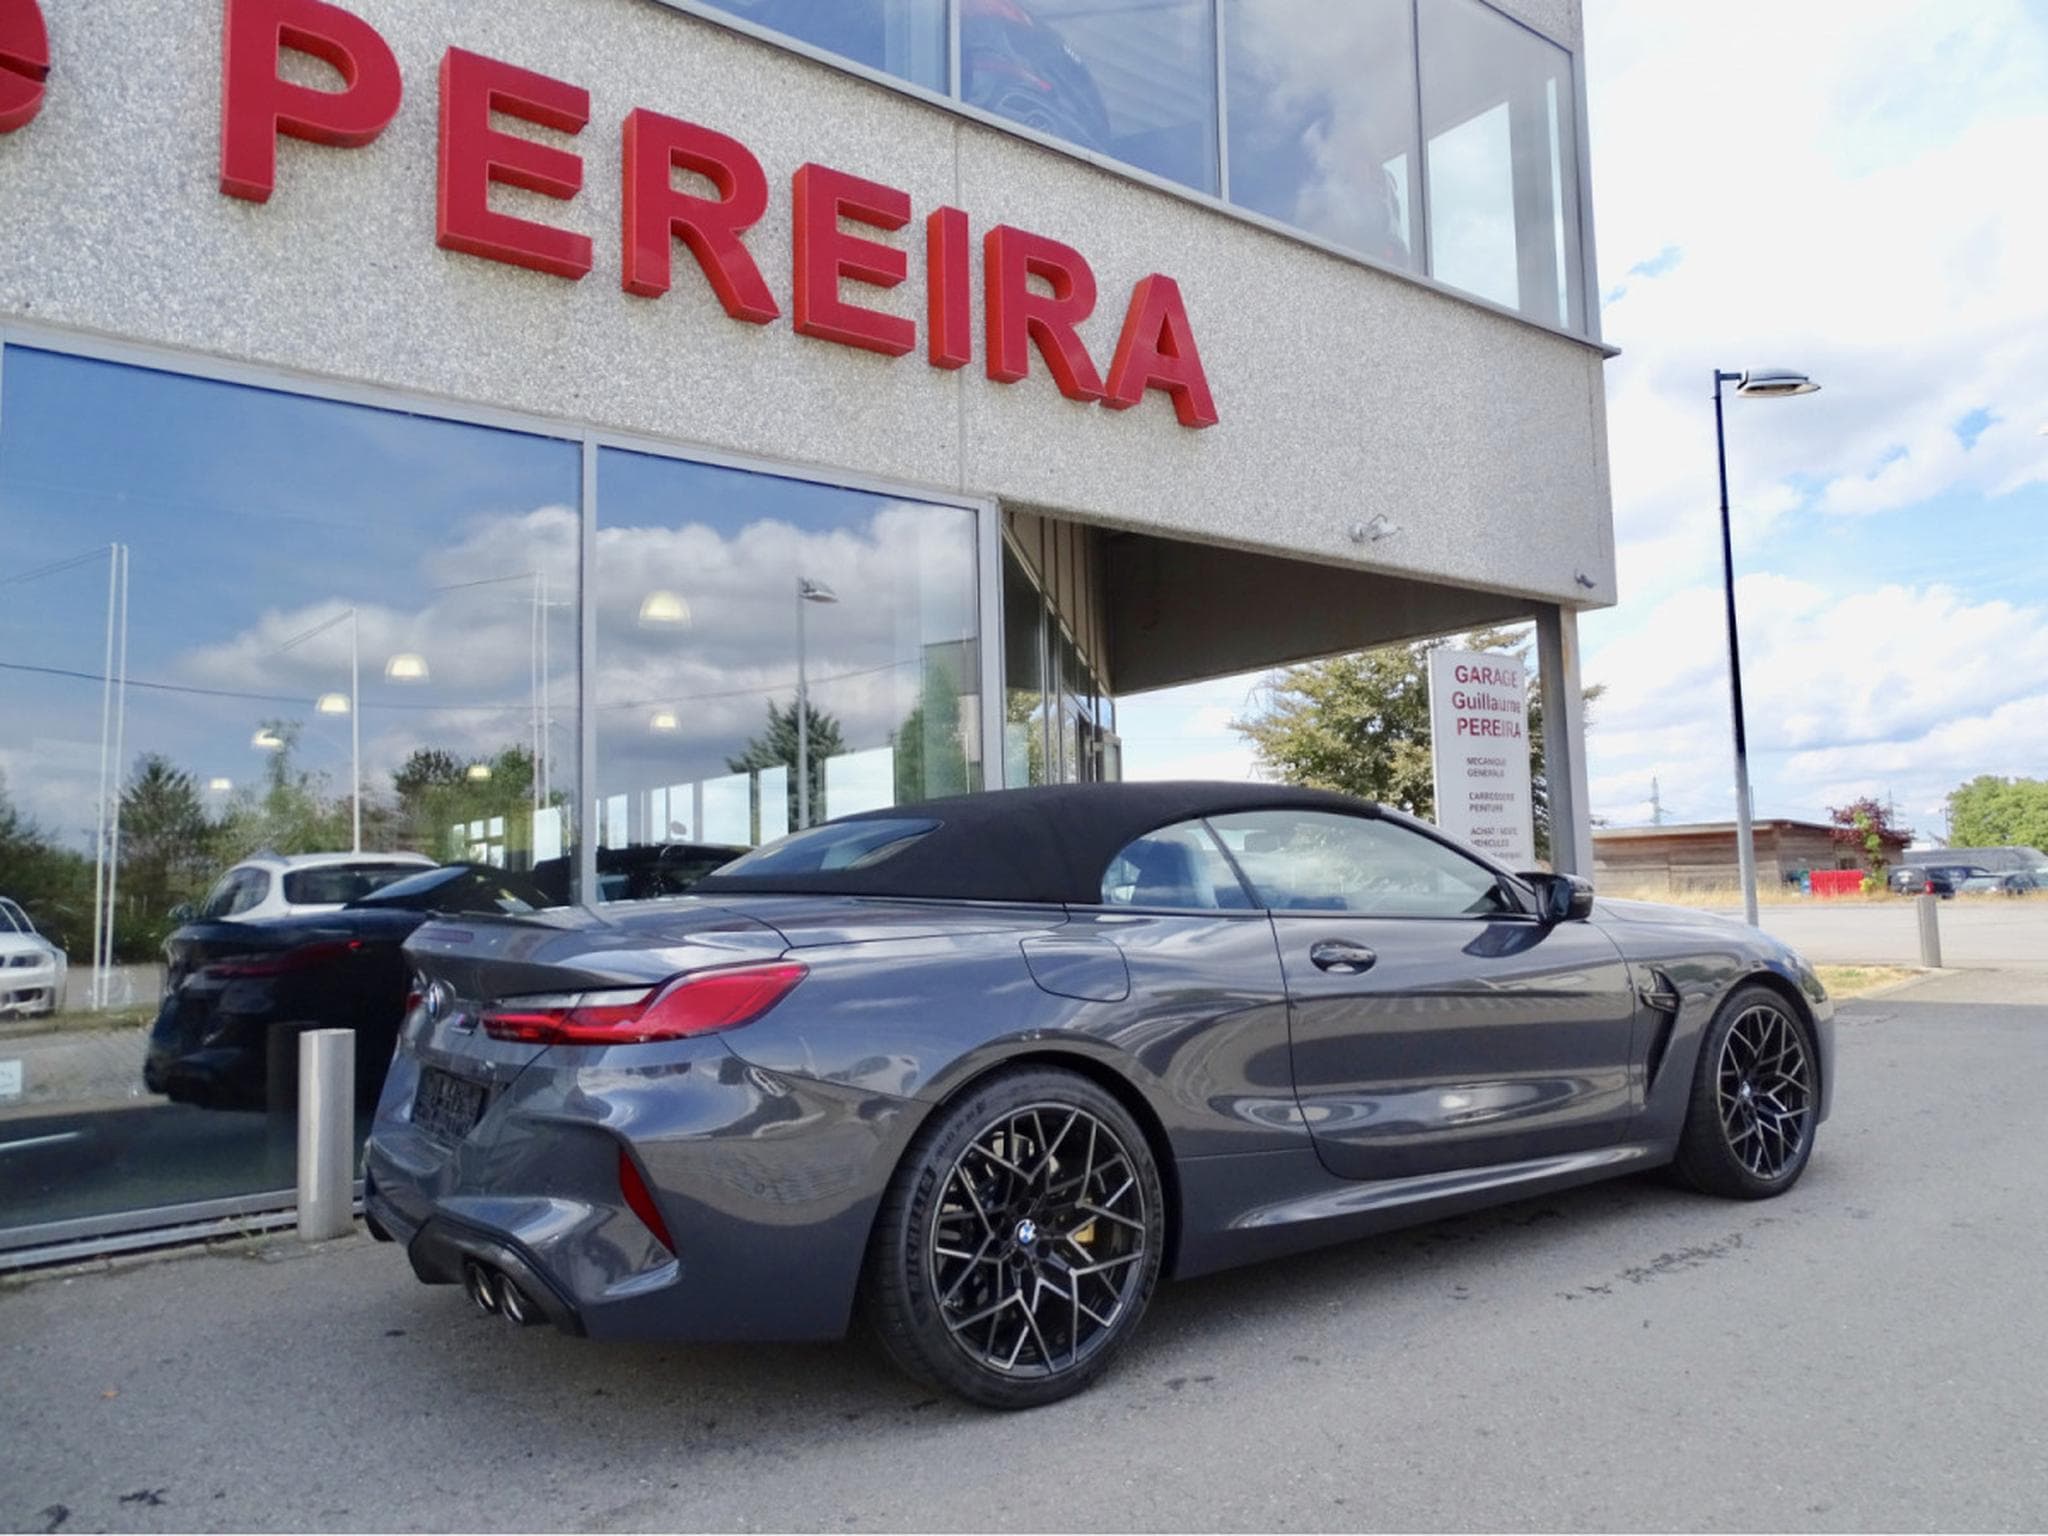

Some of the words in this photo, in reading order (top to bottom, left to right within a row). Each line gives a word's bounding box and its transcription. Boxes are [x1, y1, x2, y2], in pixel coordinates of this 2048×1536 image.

[219, 0, 1219, 429] PEREIRA
[1455, 665, 1518, 688] GARAGE
[1452, 691, 1521, 713] Guillaume
[1457, 718, 1521, 738] PEREIRA
